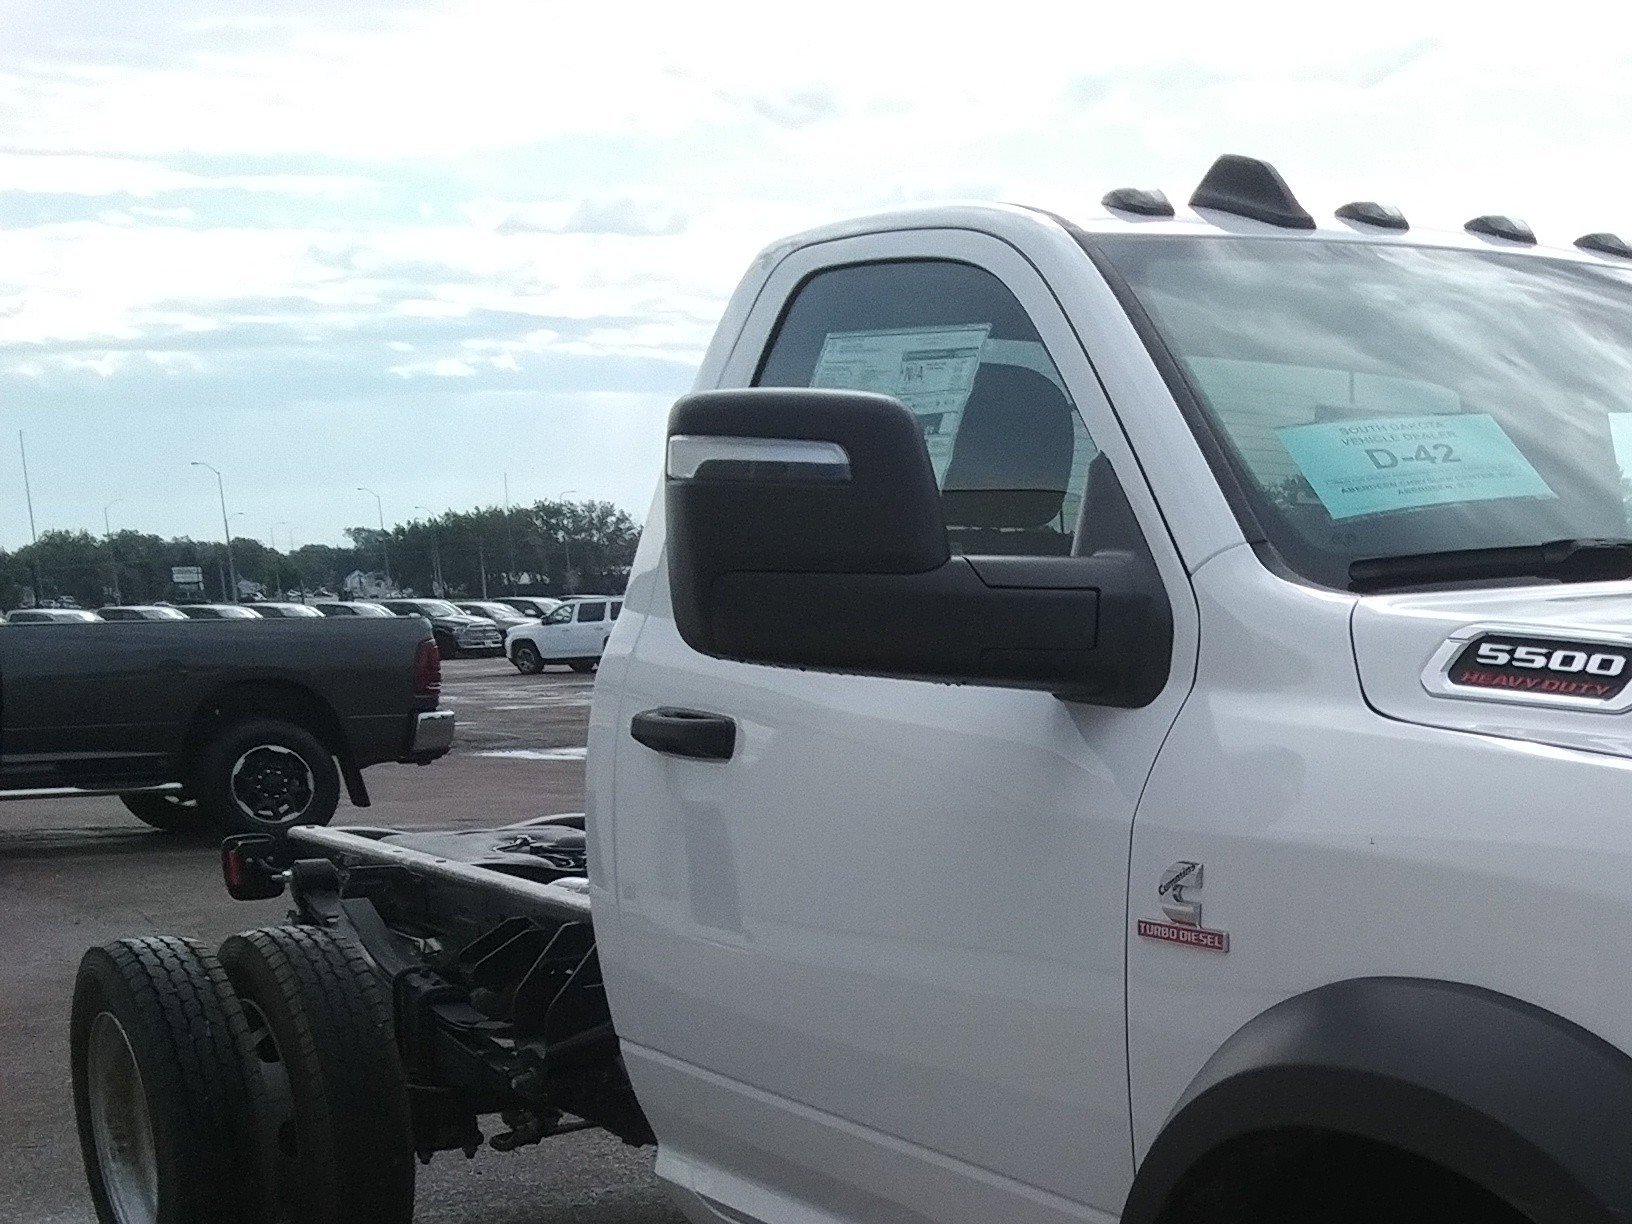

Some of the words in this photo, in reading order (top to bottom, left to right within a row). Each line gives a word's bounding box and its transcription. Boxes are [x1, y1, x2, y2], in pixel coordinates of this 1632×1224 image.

[1338, 424, 1388, 435] SOUTH
[1364, 443, 1462, 470] D-42
[1476, 642, 1627, 676] 5500
[1460, 671, 1540, 688] HEAVY
[1542, 680, 1613, 695] DUTY
[1139, 922, 1178, 939] TURBO
[1180, 930, 1221, 948] DIESEL
